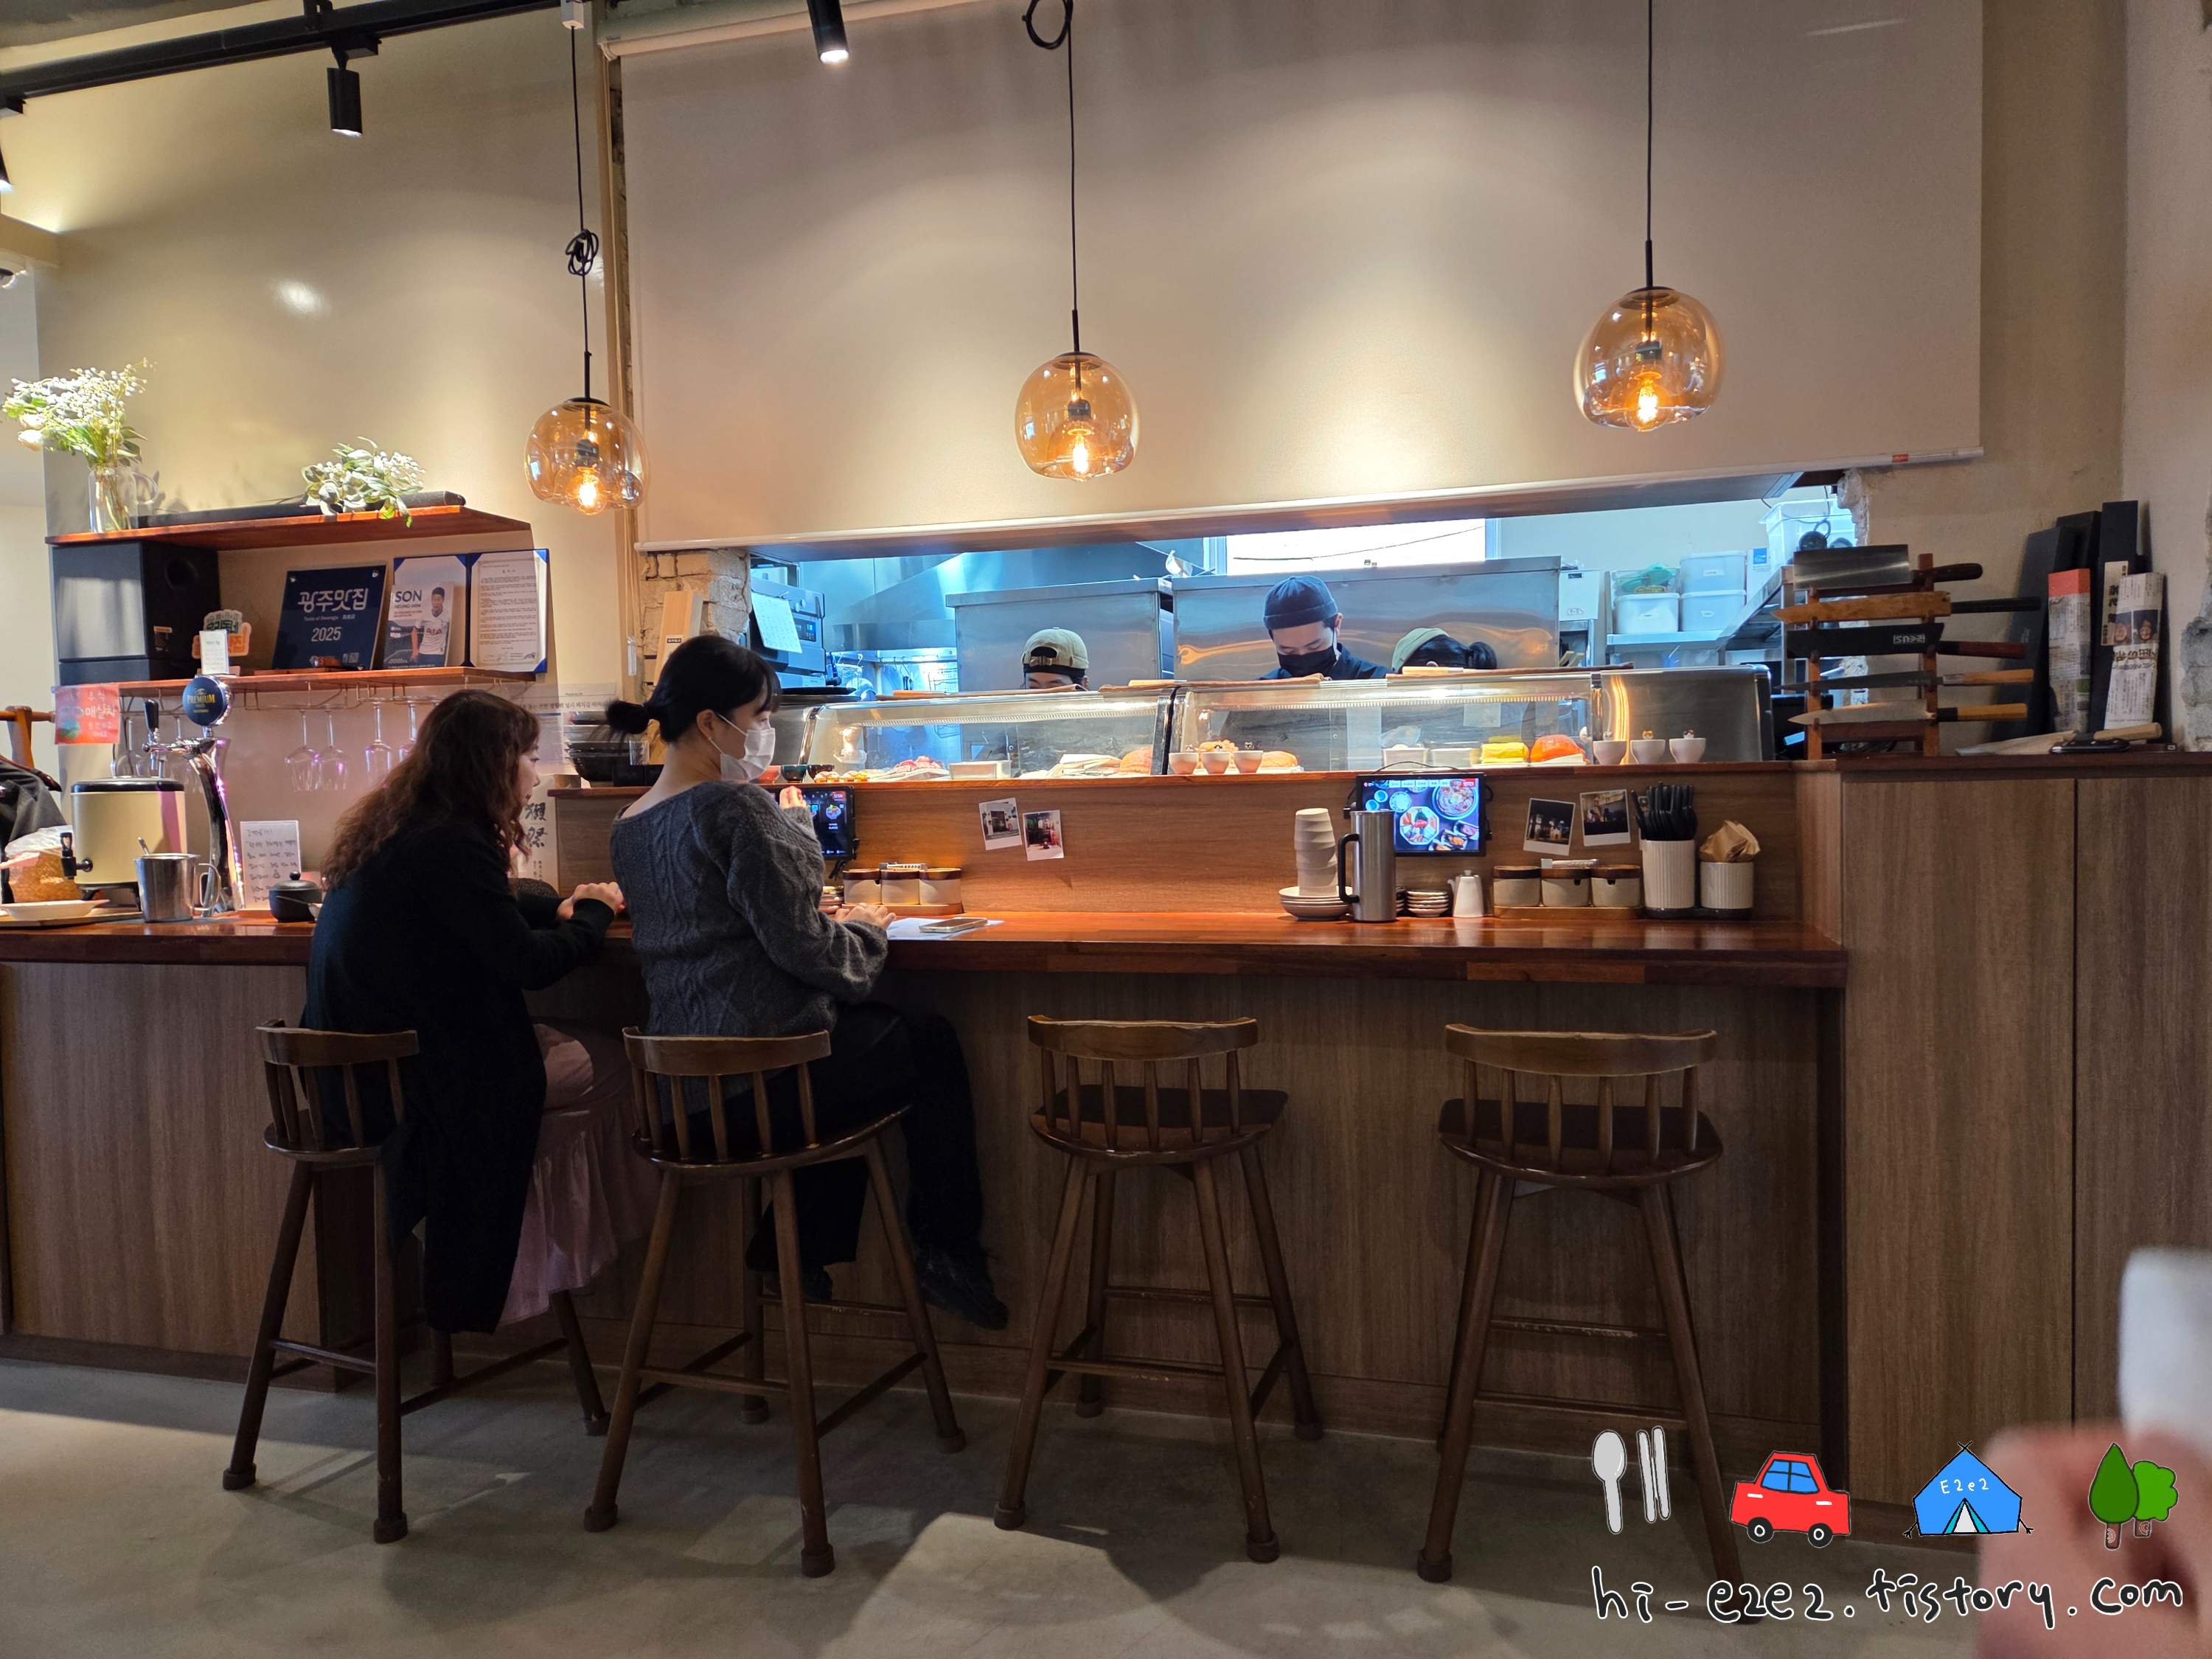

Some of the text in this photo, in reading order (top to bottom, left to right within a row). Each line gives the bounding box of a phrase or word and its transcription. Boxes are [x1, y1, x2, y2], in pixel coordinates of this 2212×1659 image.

[297, 588, 369, 613] 광주맛집
[394, 589, 422, 602] SON
[311, 627, 341, 642] 2025
[187, 694, 215, 704] PREMIUM
[85, 703, 117, 720] 매실차
